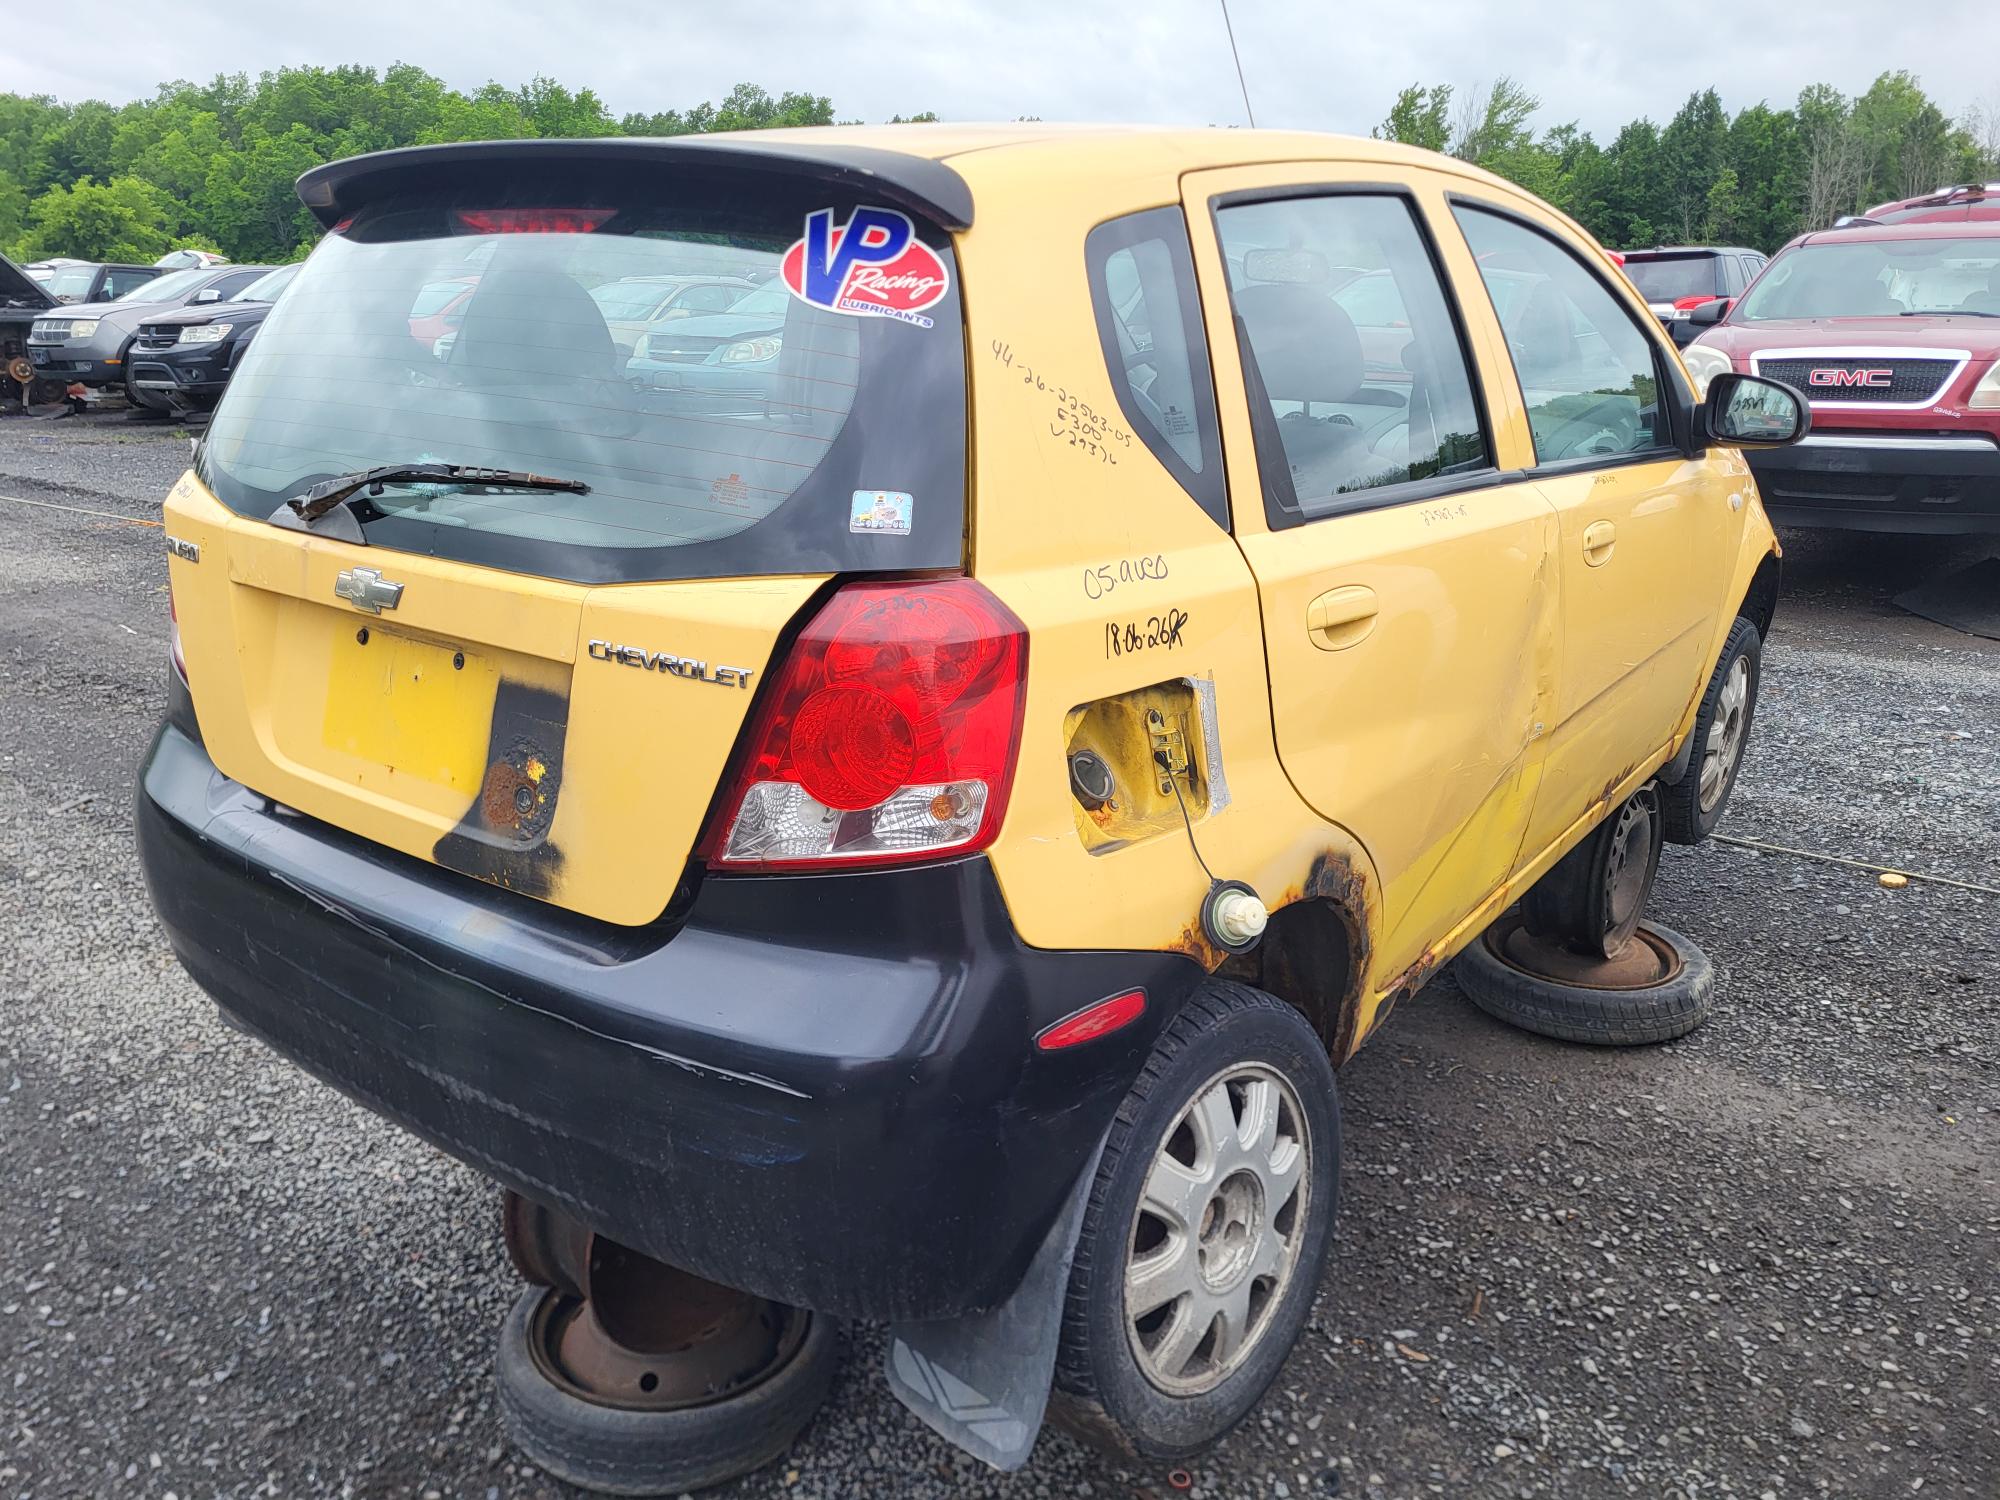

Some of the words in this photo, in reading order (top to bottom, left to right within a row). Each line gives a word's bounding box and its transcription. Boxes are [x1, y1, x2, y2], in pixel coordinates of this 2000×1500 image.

[804, 205, 914, 309] VP
[845, 267, 945, 300] Racing
[842, 299, 933, 328] LUBRICANTS
[1809, 369, 1893, 387] GMC
[588, 638, 754, 689] CHEVROLET
